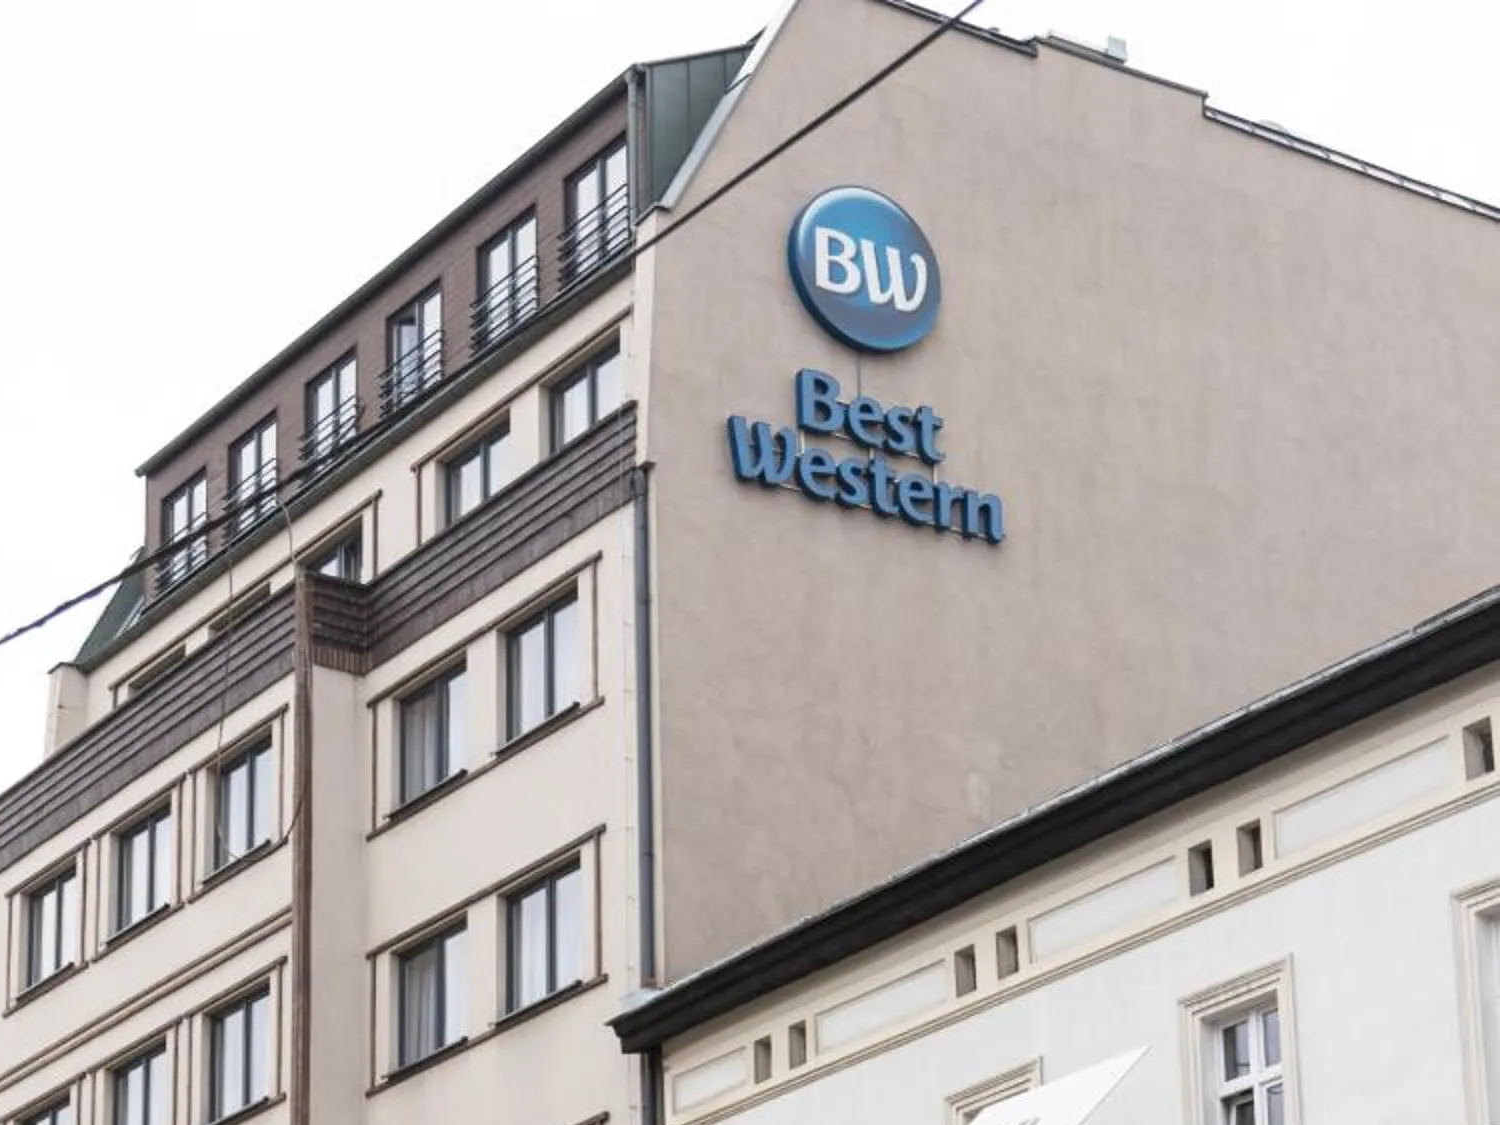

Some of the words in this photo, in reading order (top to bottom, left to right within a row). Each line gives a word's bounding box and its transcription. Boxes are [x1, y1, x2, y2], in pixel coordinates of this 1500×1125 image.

[814, 226, 927, 312] BW
[796, 368, 946, 465] Best
[727, 415, 1006, 545] Western
